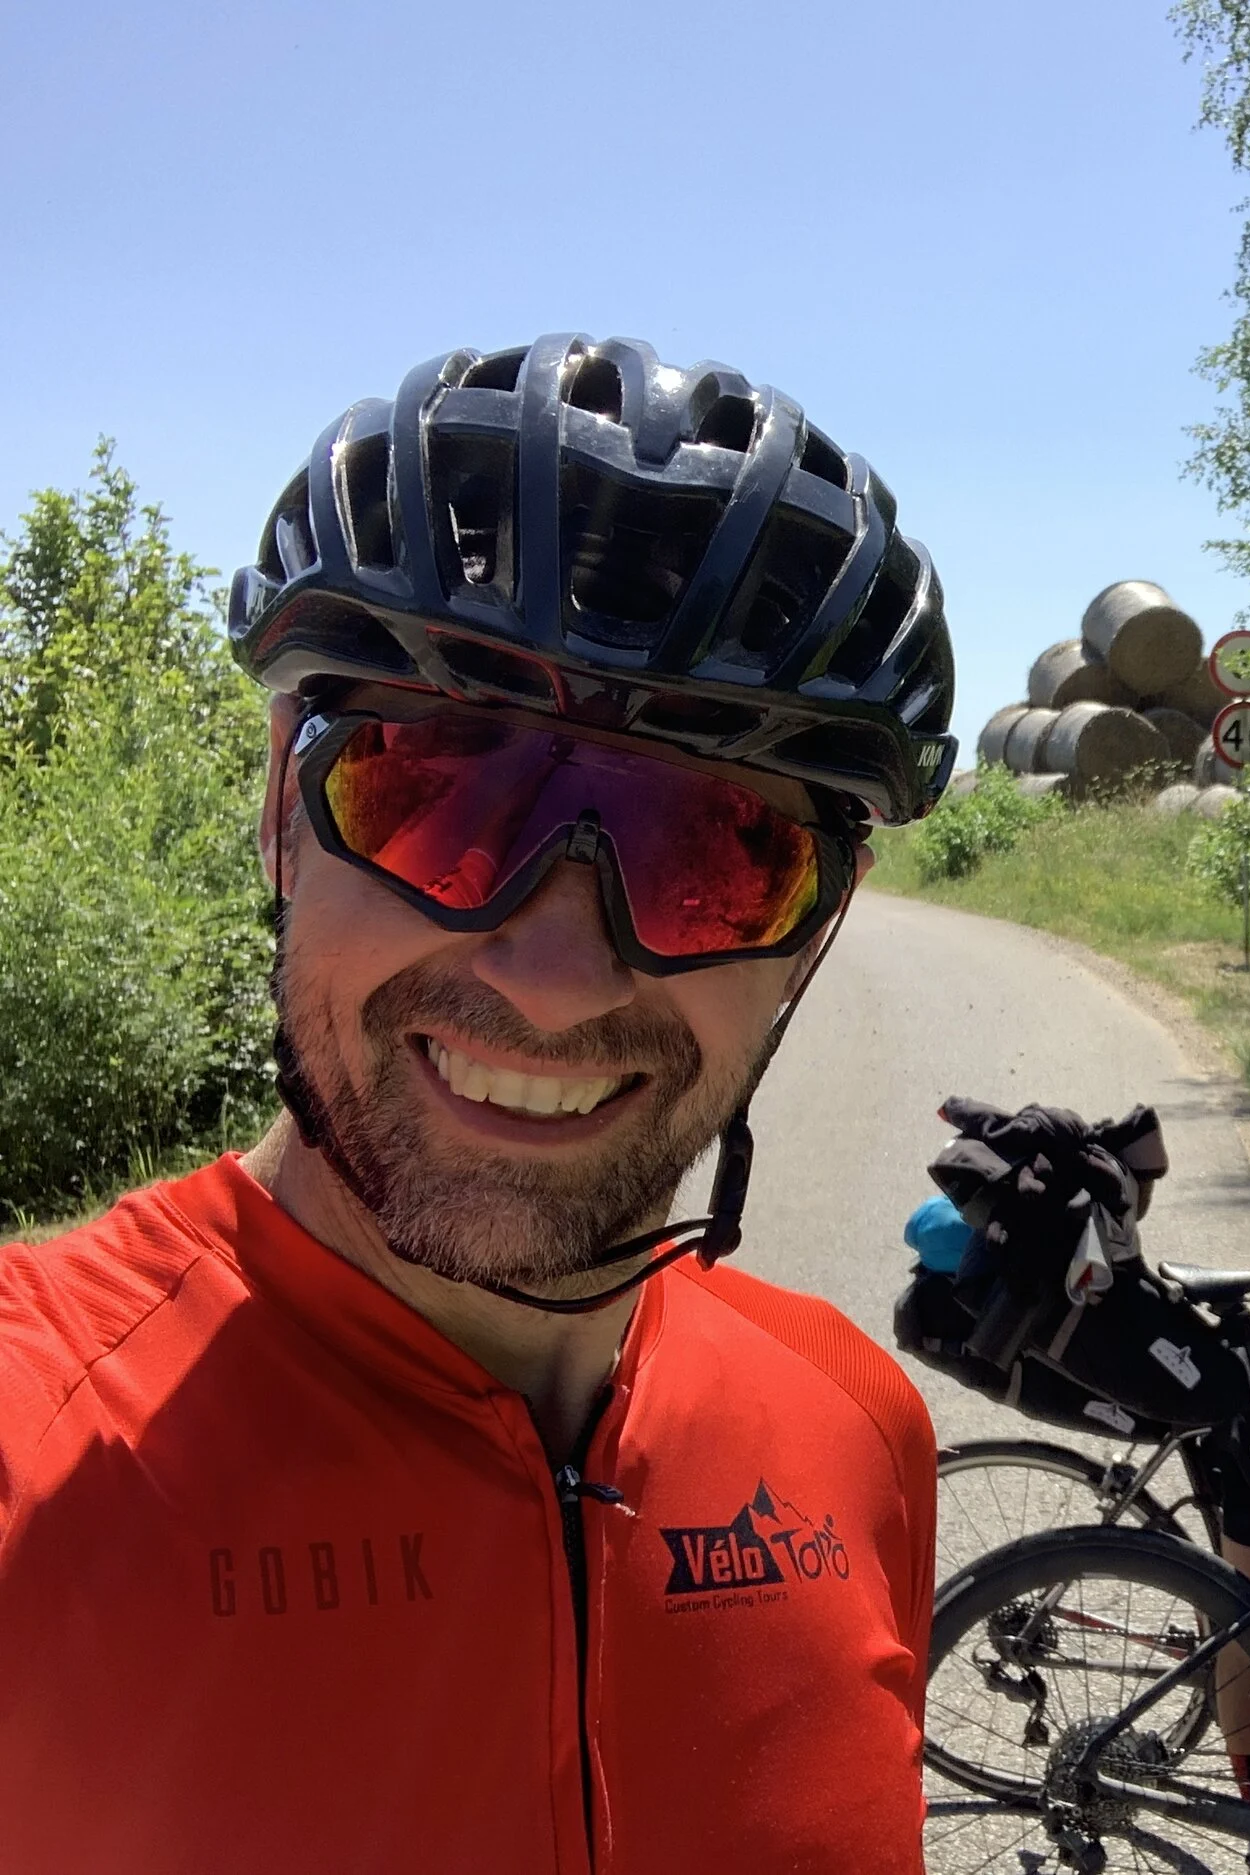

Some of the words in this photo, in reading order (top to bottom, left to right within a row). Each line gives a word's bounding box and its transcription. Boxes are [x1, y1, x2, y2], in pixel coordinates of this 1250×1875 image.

[209, 1532, 434, 1617] GOBIK
[681, 1531, 766, 1585] Vélo
[664, 1598, 711, 1614] Custom
[712, 1592, 754, 1610] Cycling
[756, 1590, 789, 1604] Tours
